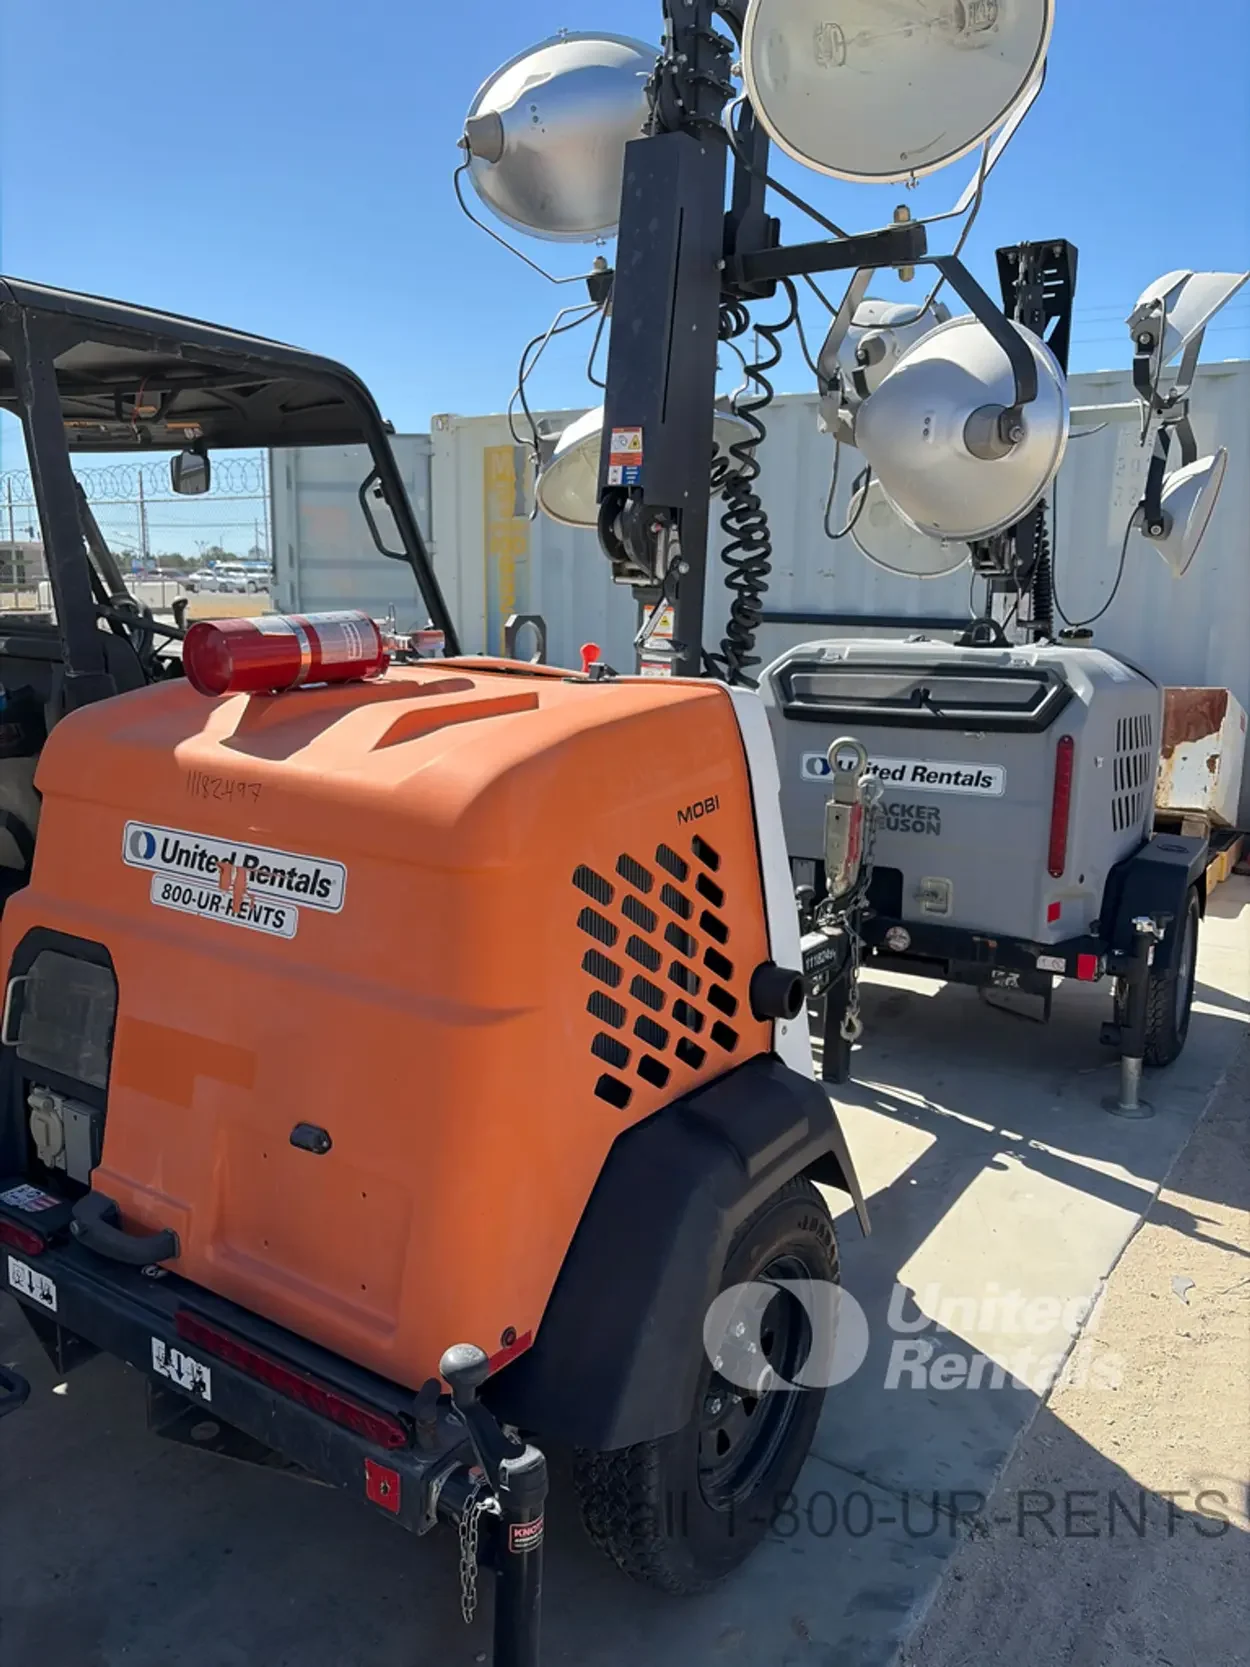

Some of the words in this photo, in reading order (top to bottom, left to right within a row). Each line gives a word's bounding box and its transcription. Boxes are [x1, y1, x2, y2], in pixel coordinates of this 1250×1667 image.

[838, 760, 906, 781] Uited
[911, 765, 993, 788] Rentals
[677, 795, 720, 826] MOBI
[872, 802, 941, 821] ACKER
[873, 815, 941, 836] EUSON
[242, 853, 333, 899] Rentals
